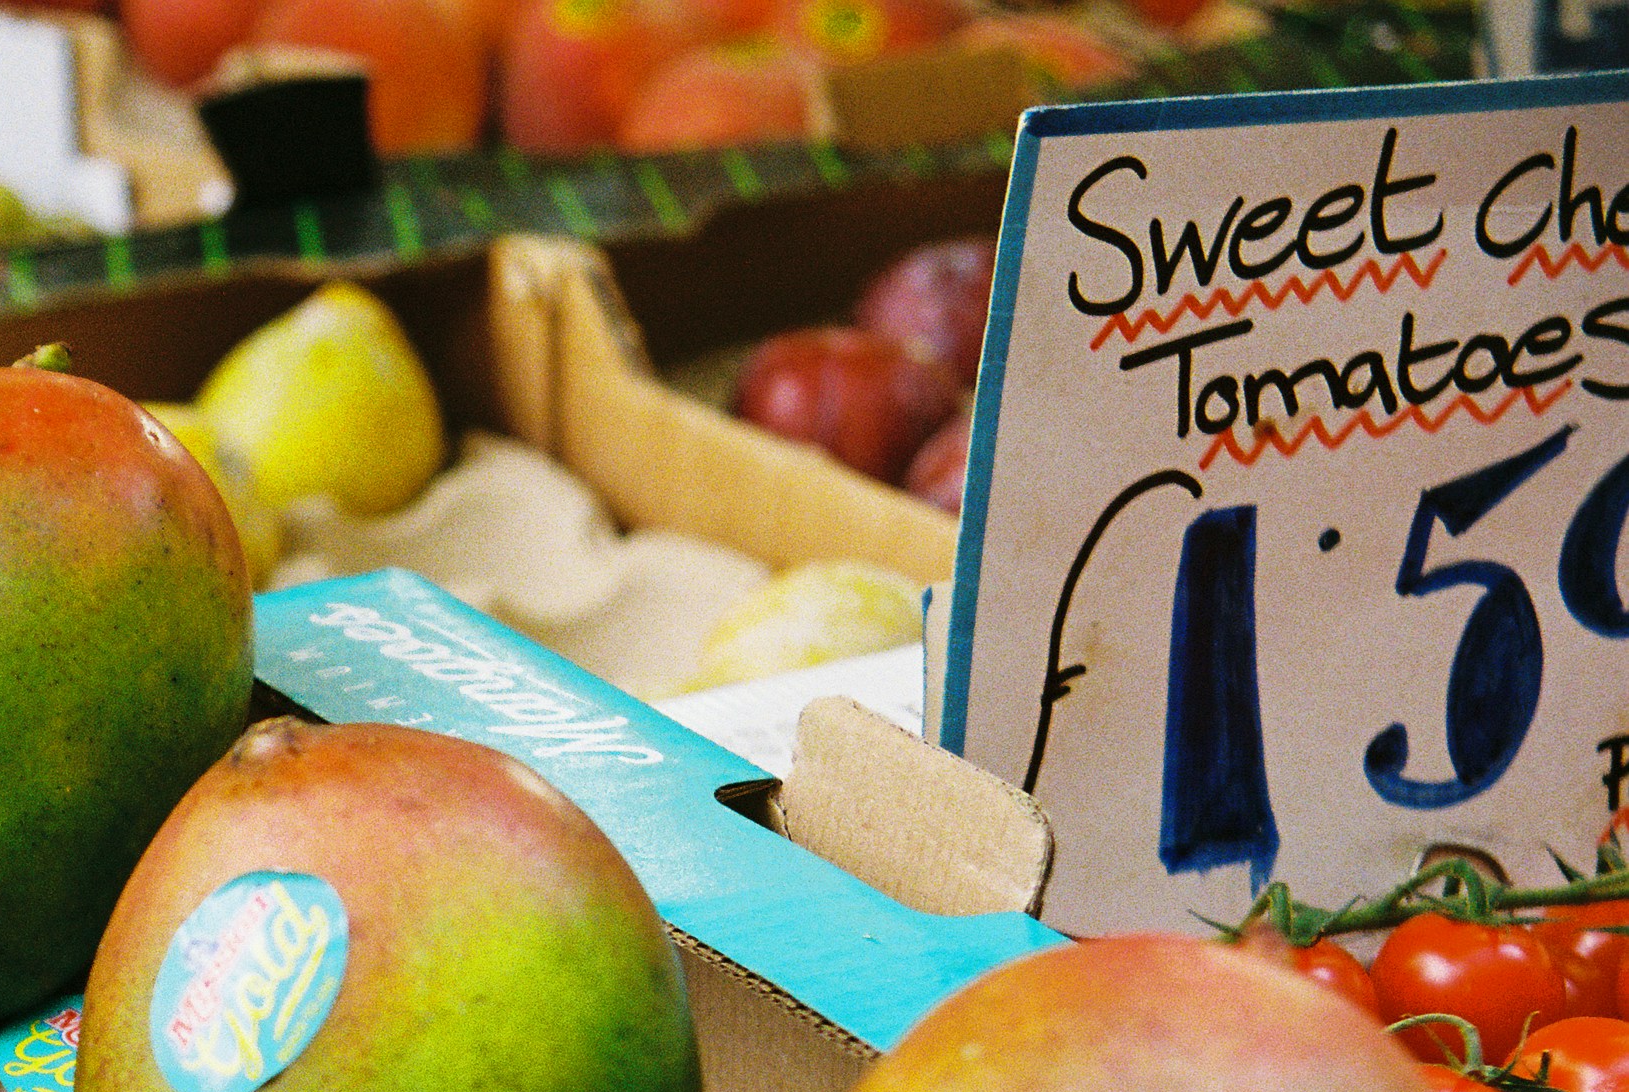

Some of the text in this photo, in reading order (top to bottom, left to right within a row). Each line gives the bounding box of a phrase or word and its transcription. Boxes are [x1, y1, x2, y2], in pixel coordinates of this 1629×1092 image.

[1067, 127, 1446, 317] Sweet
[286, 645, 466, 739] EMIUM
[308, 601, 665, 766] Mangoes
[182, 879, 330, 1082] Gold
